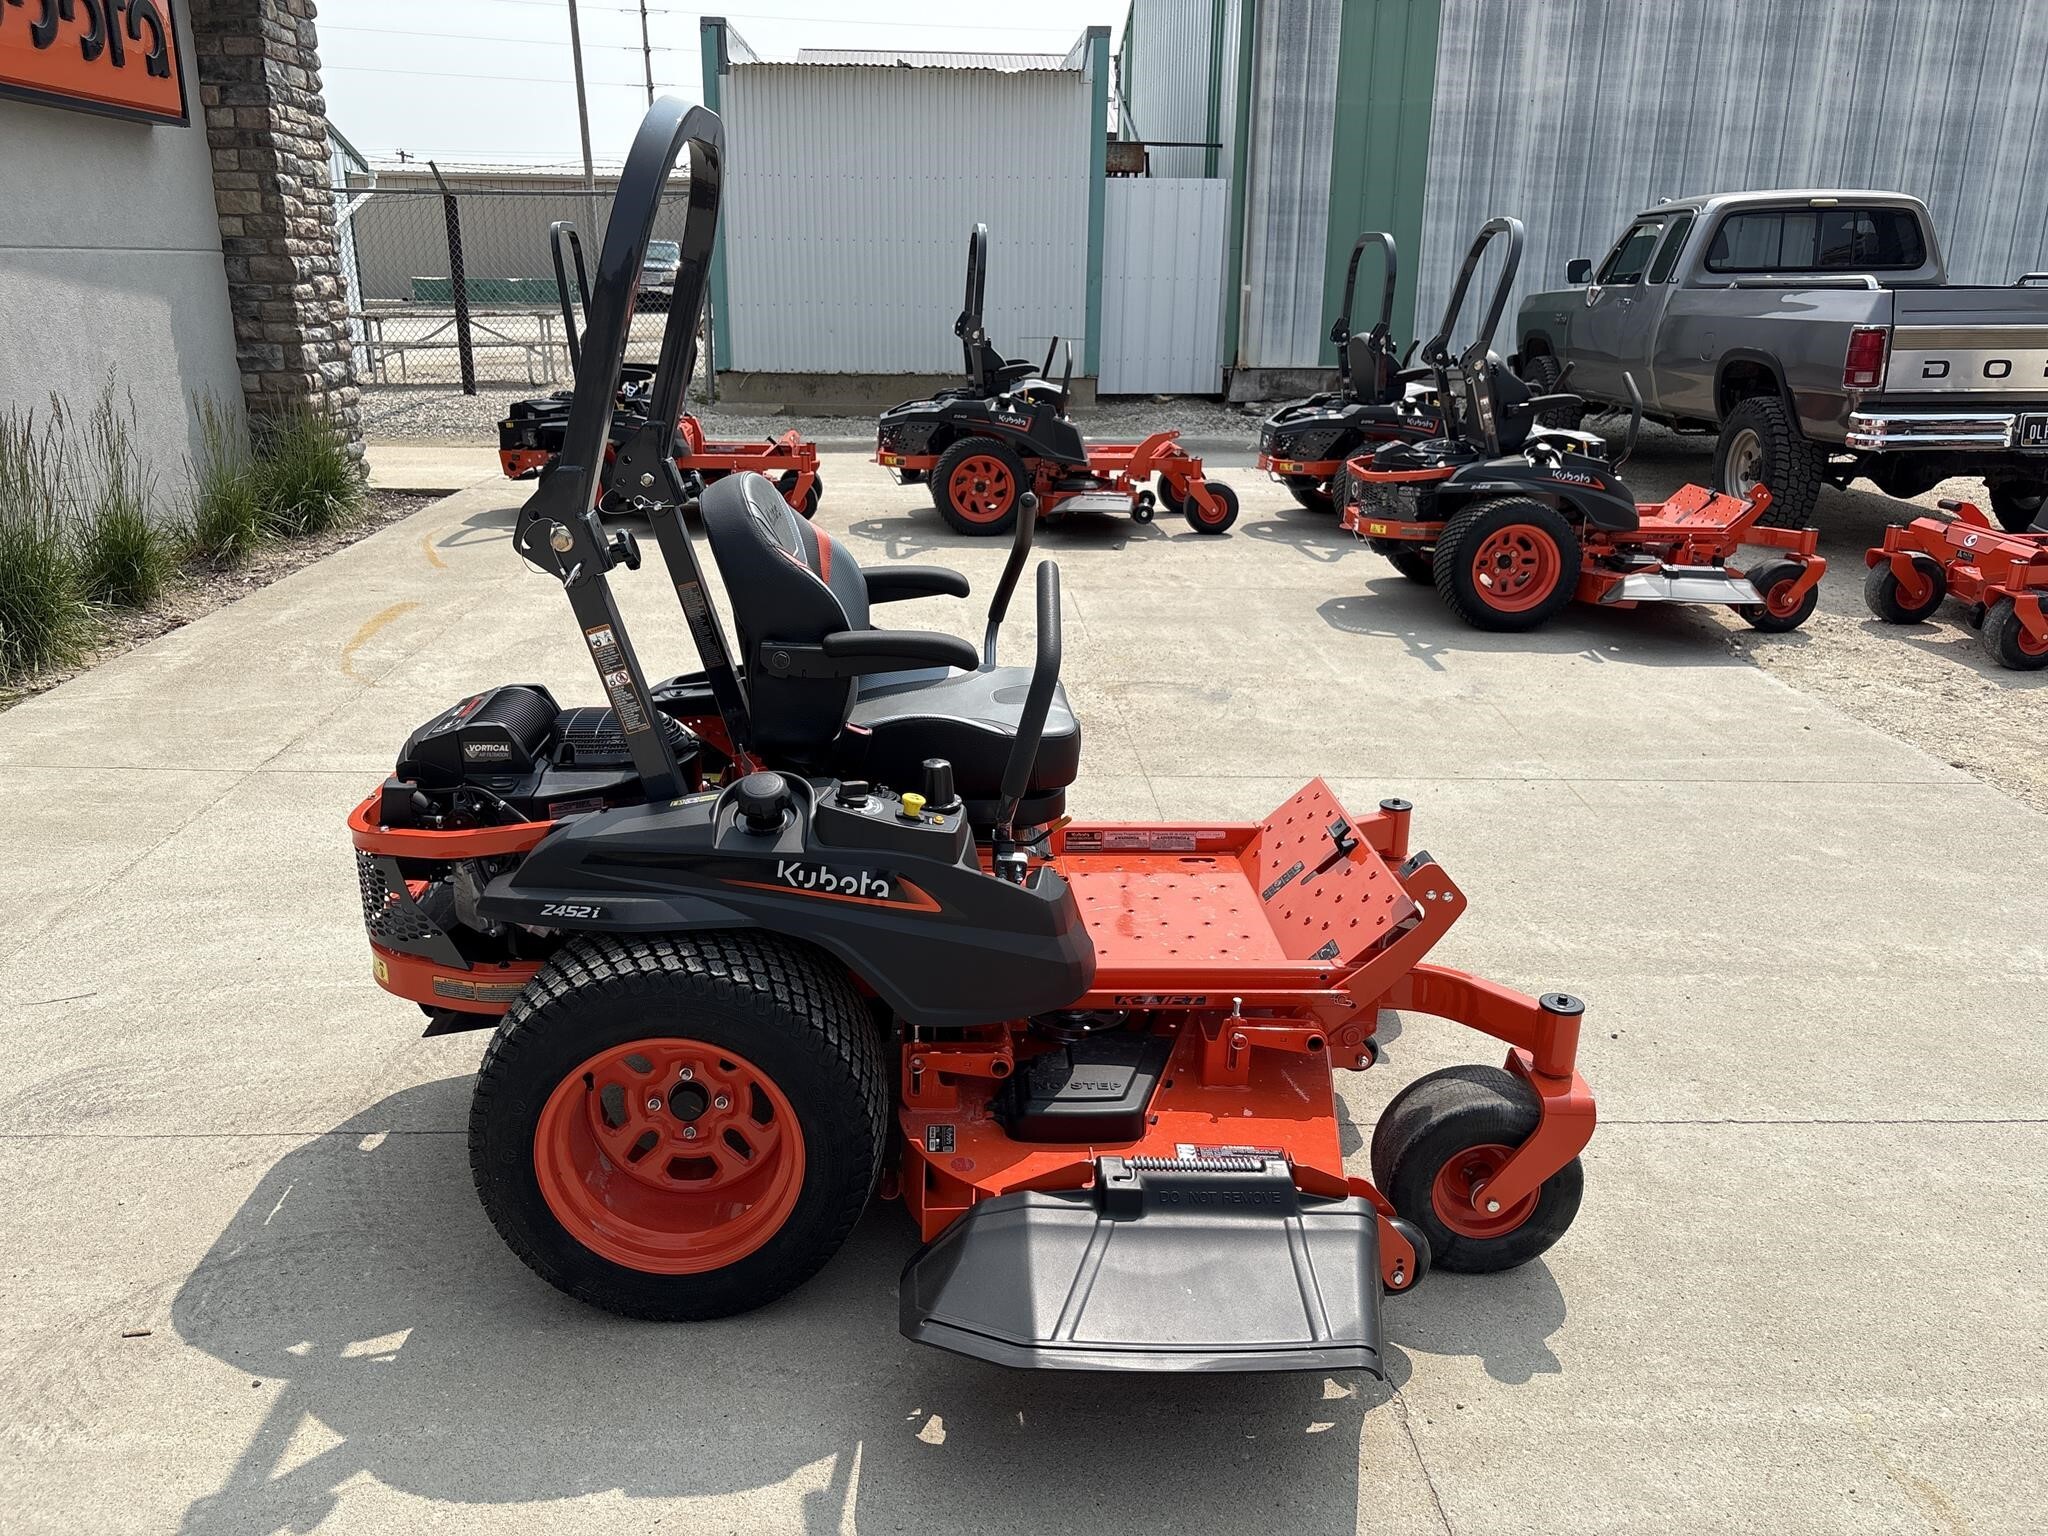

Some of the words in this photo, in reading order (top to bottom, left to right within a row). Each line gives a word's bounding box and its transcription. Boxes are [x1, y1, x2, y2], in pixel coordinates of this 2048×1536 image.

[1921, 359, 2048, 378] DO
[998, 414, 1026, 426] Kubota
[1407, 418, 1433, 428] Kubota
[1552, 470, 1591, 483] Kubota
[469, 744, 510, 752] VORTICAL
[776, 859, 890, 898] Kubota
[540, 904, 600, 918] Z452i
[1070, 1081, 1122, 1091] STEP
[1160, 1190, 1180, 1204] DO
[1188, 1191, 1217, 1204] NOT
[1222, 1191, 1281, 1204] REMOVE
